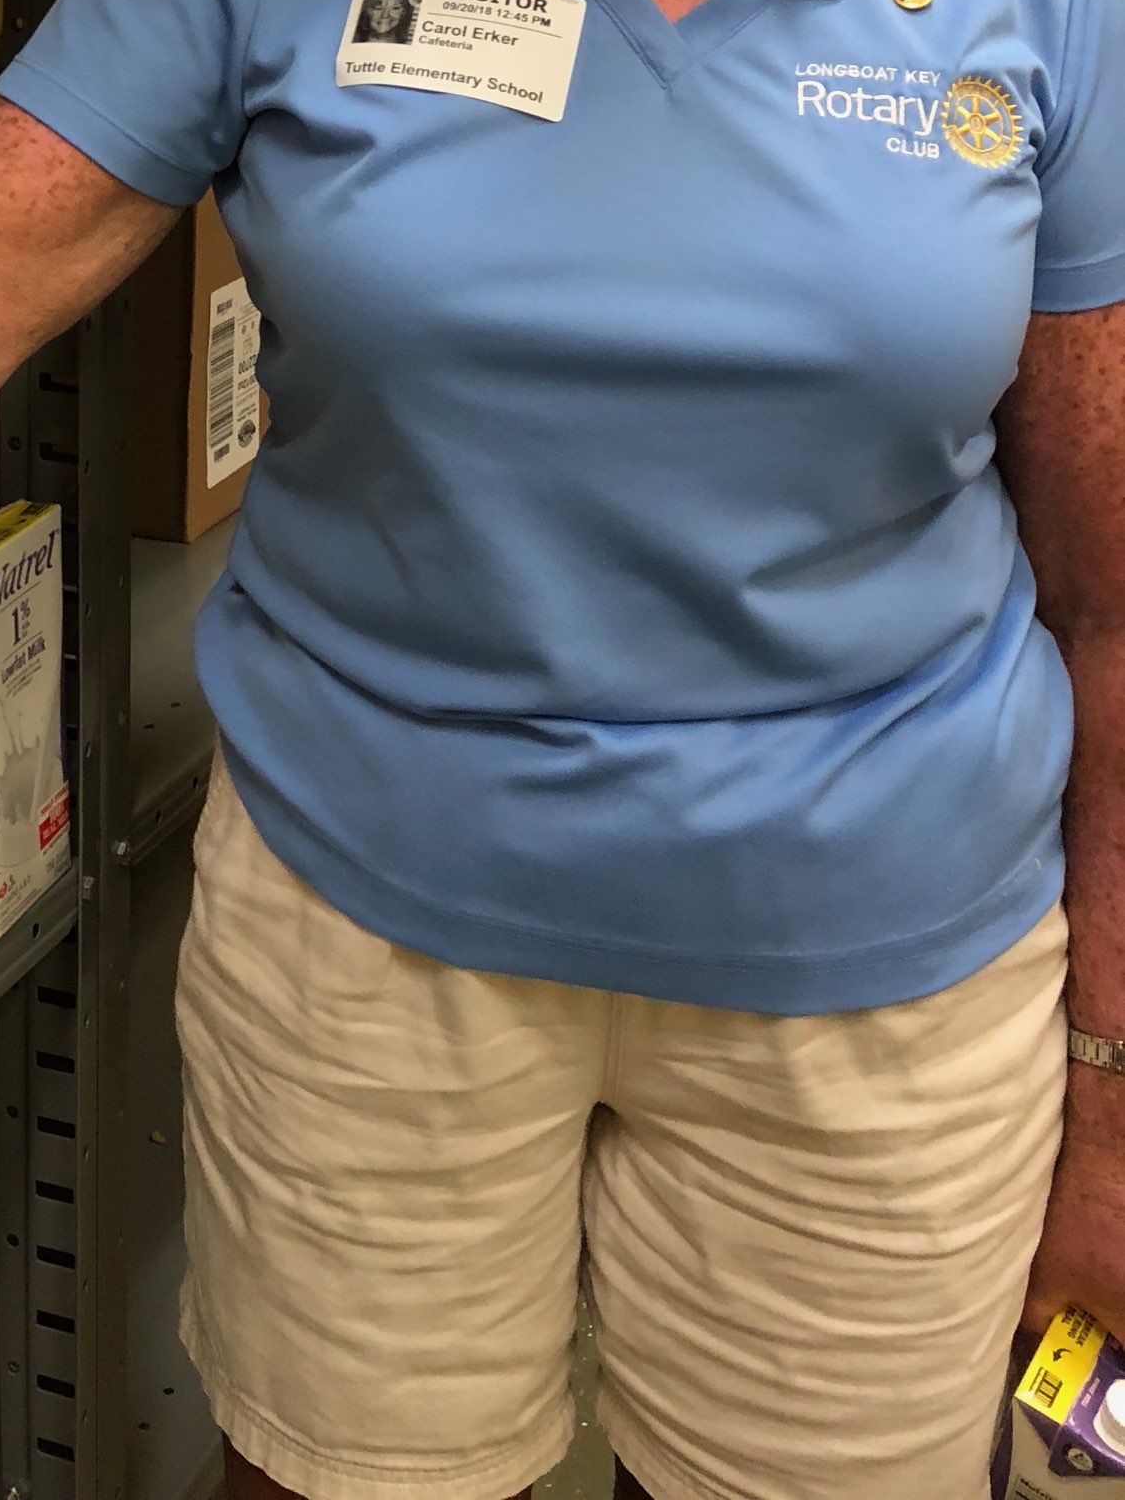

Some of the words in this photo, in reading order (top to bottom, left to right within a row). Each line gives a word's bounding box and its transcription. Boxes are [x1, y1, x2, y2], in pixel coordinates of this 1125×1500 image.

[442, 1, 492, 17] 09/20/18
[496, 8, 528, 23] 12:45
[531, 16, 551, 28] PM
[418, 35, 473, 51] Cafeteria
[421, 20, 466, 39] Carol
[472, 27, 519, 47] Erker
[345, 61, 386, 74] Tuttle
[391, 63, 482, 88] Elementary
[487, 78, 543, 104] School
[795, 63, 898, 81] LONGBOAT
[905, 70, 941, 87] KEY
[797, 80, 939, 136] Rotary
[885, 137, 941, 160] CLUB
[12, 599, 31, 646] 1%
